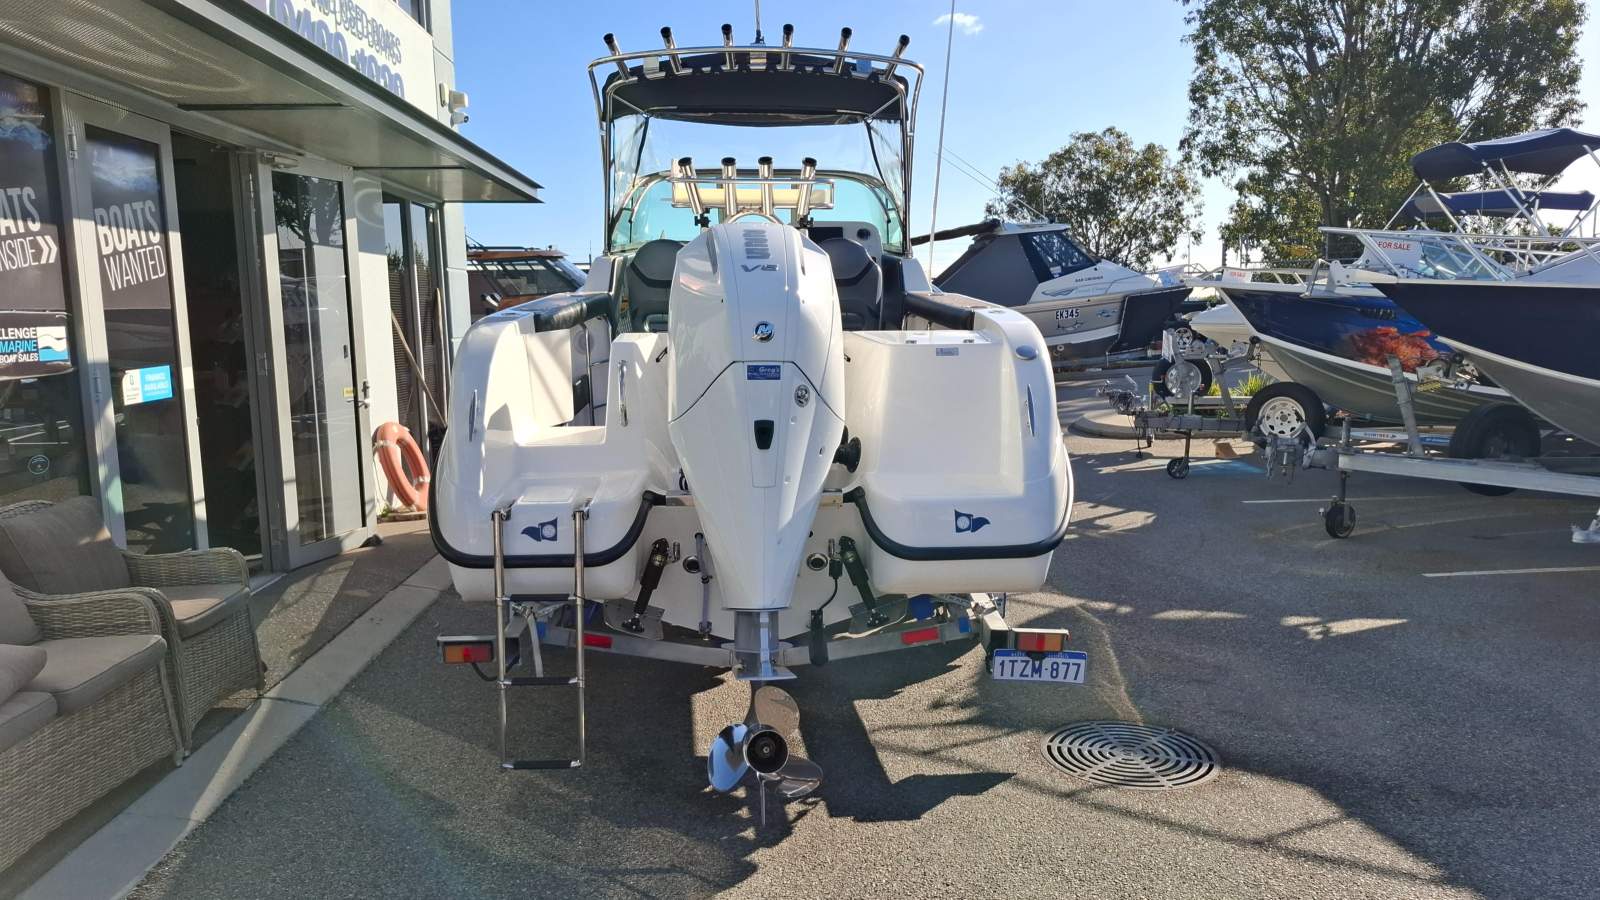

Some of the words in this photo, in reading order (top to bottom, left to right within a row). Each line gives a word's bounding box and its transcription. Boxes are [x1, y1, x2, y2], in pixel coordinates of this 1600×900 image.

[95, 200, 160, 255] BOATS
[103, 245, 166, 291] WANTED
[1055, 309, 1080, 320] EK345
[0, 327, 37, 339] LENGE
[0, 339, 37, 353] MARINE
[18, 352, 39, 363] SALES
